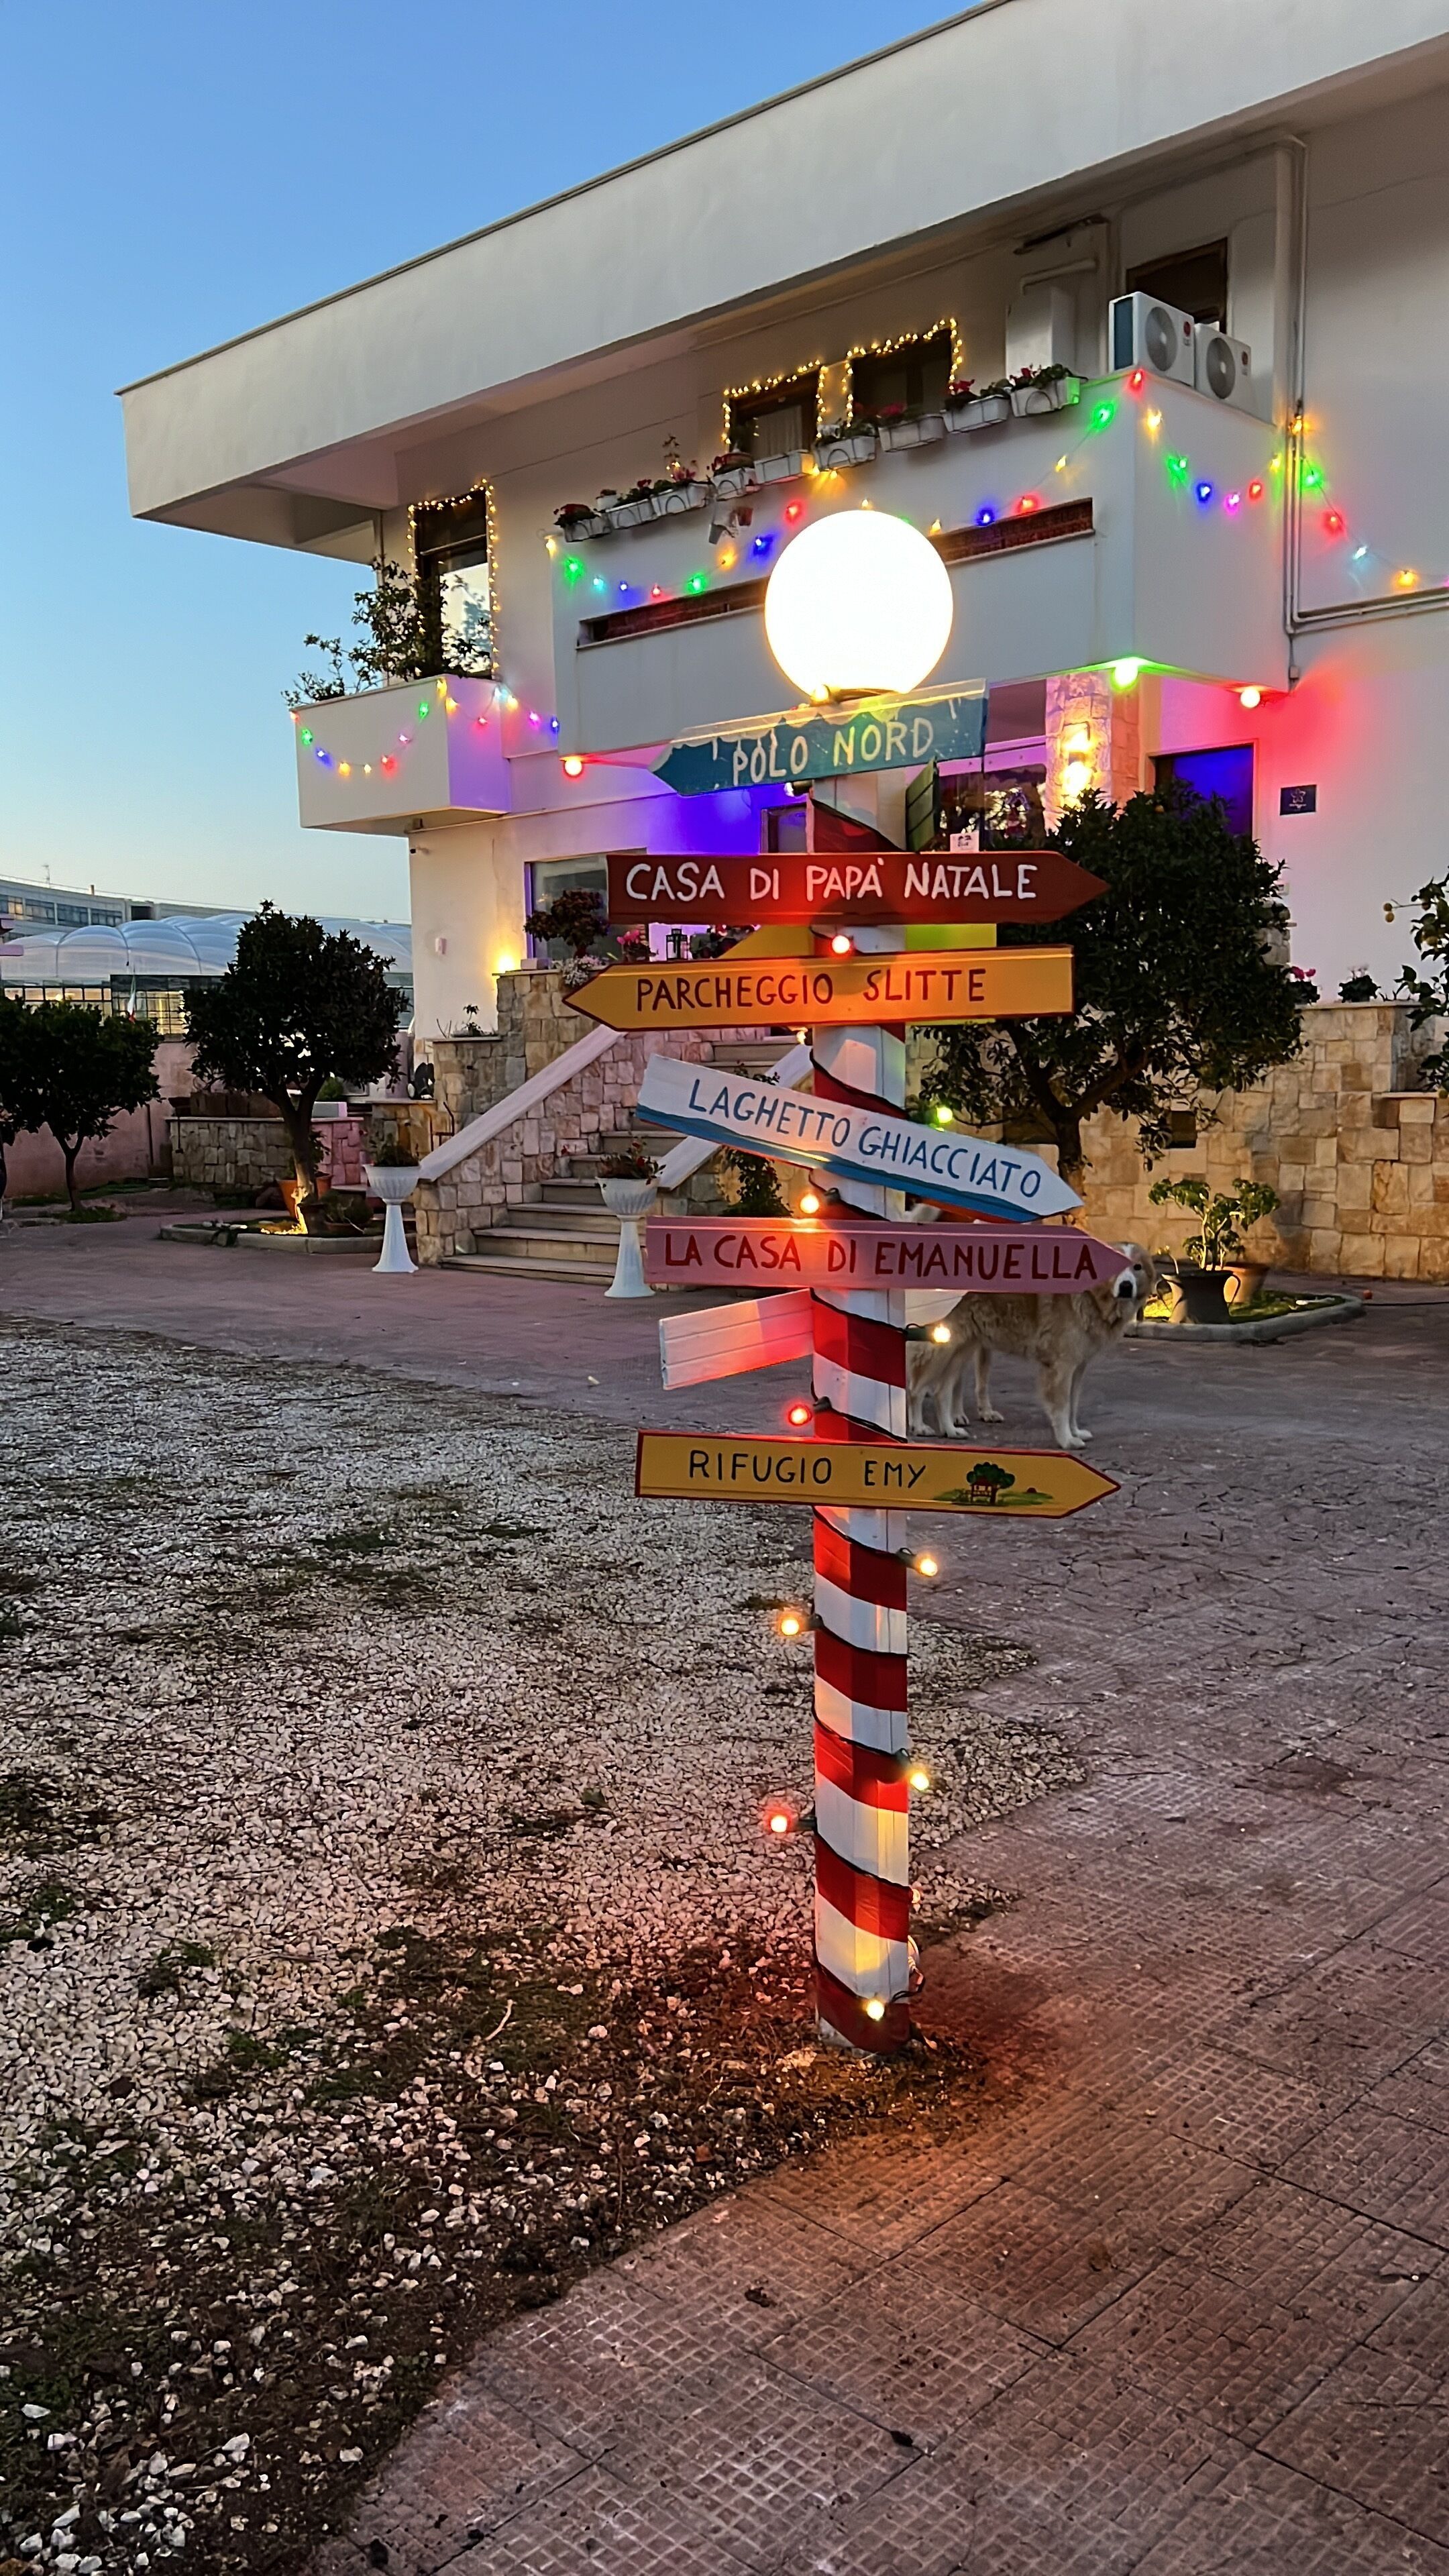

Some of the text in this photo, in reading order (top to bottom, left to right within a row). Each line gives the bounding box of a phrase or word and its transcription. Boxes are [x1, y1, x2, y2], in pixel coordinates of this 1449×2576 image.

[732, 716, 934, 786] POLO NORD
[625, 857, 1038, 902] CASA DI PAPÀ NATALE
[636, 968, 987, 1011] PARCHEGGIO SLITTE
[688, 1079, 1042, 1199] LAGHETTO GHIACCIATO
[664, 1233, 1098, 1281] LA CASA DI EMANUELLA
[688, 1449, 927, 1487] RIFUGIO EMY
